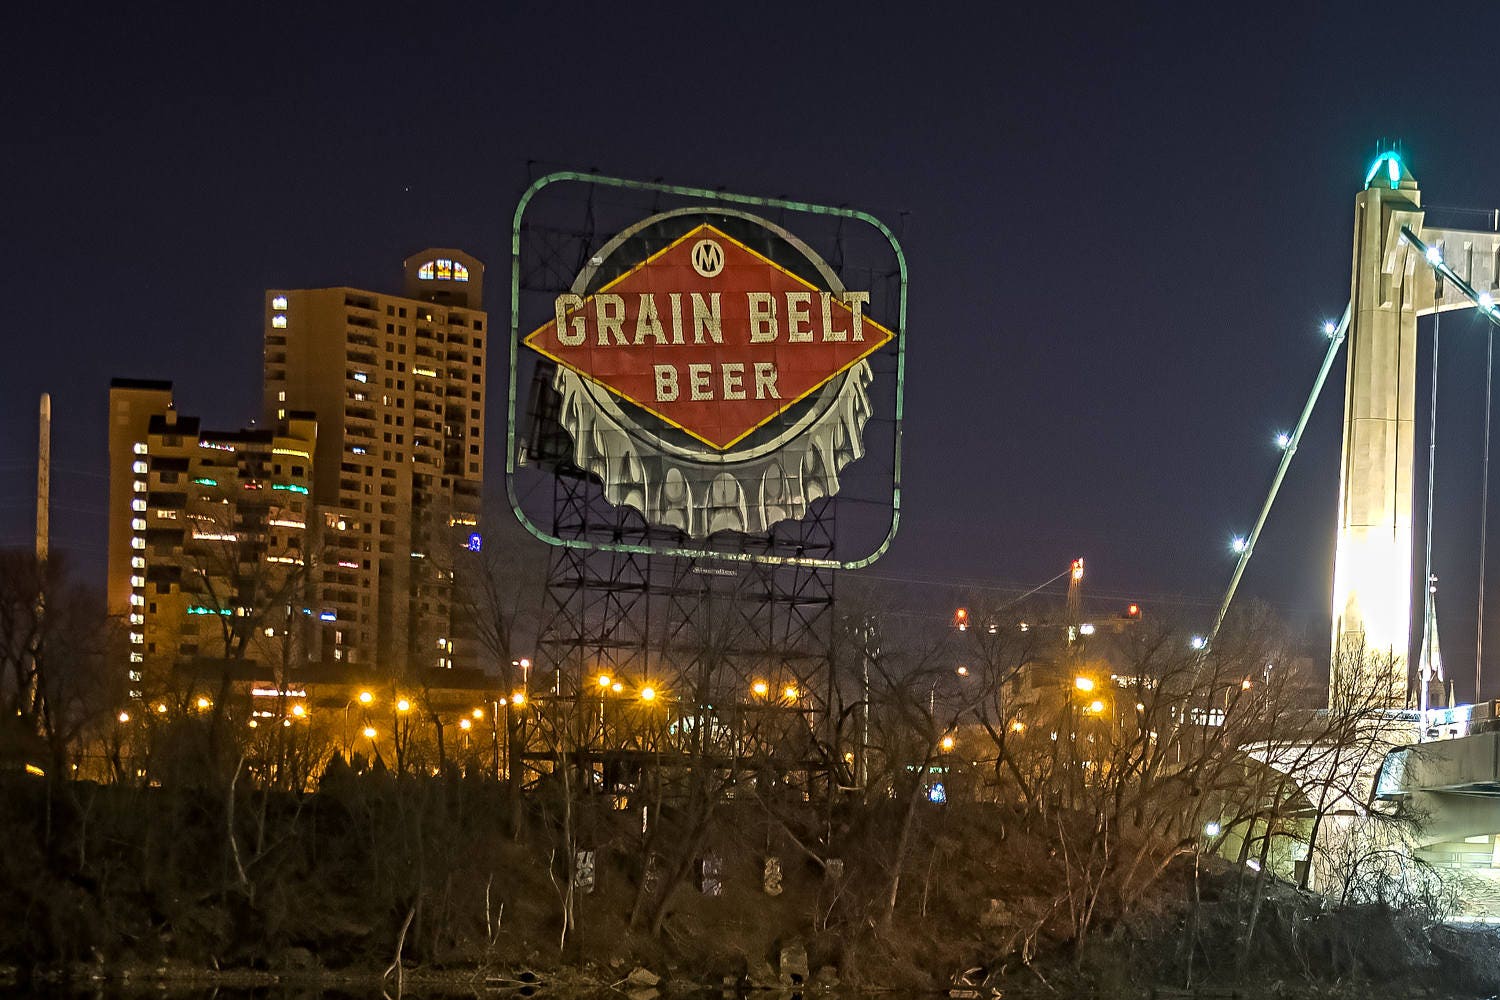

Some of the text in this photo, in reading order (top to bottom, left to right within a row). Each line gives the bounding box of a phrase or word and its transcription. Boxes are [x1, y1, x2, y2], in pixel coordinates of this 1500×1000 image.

[697, 243, 720, 272] M
[555, 291, 870, 347] GRAIN BELT
[653, 362, 782, 402] BEER
